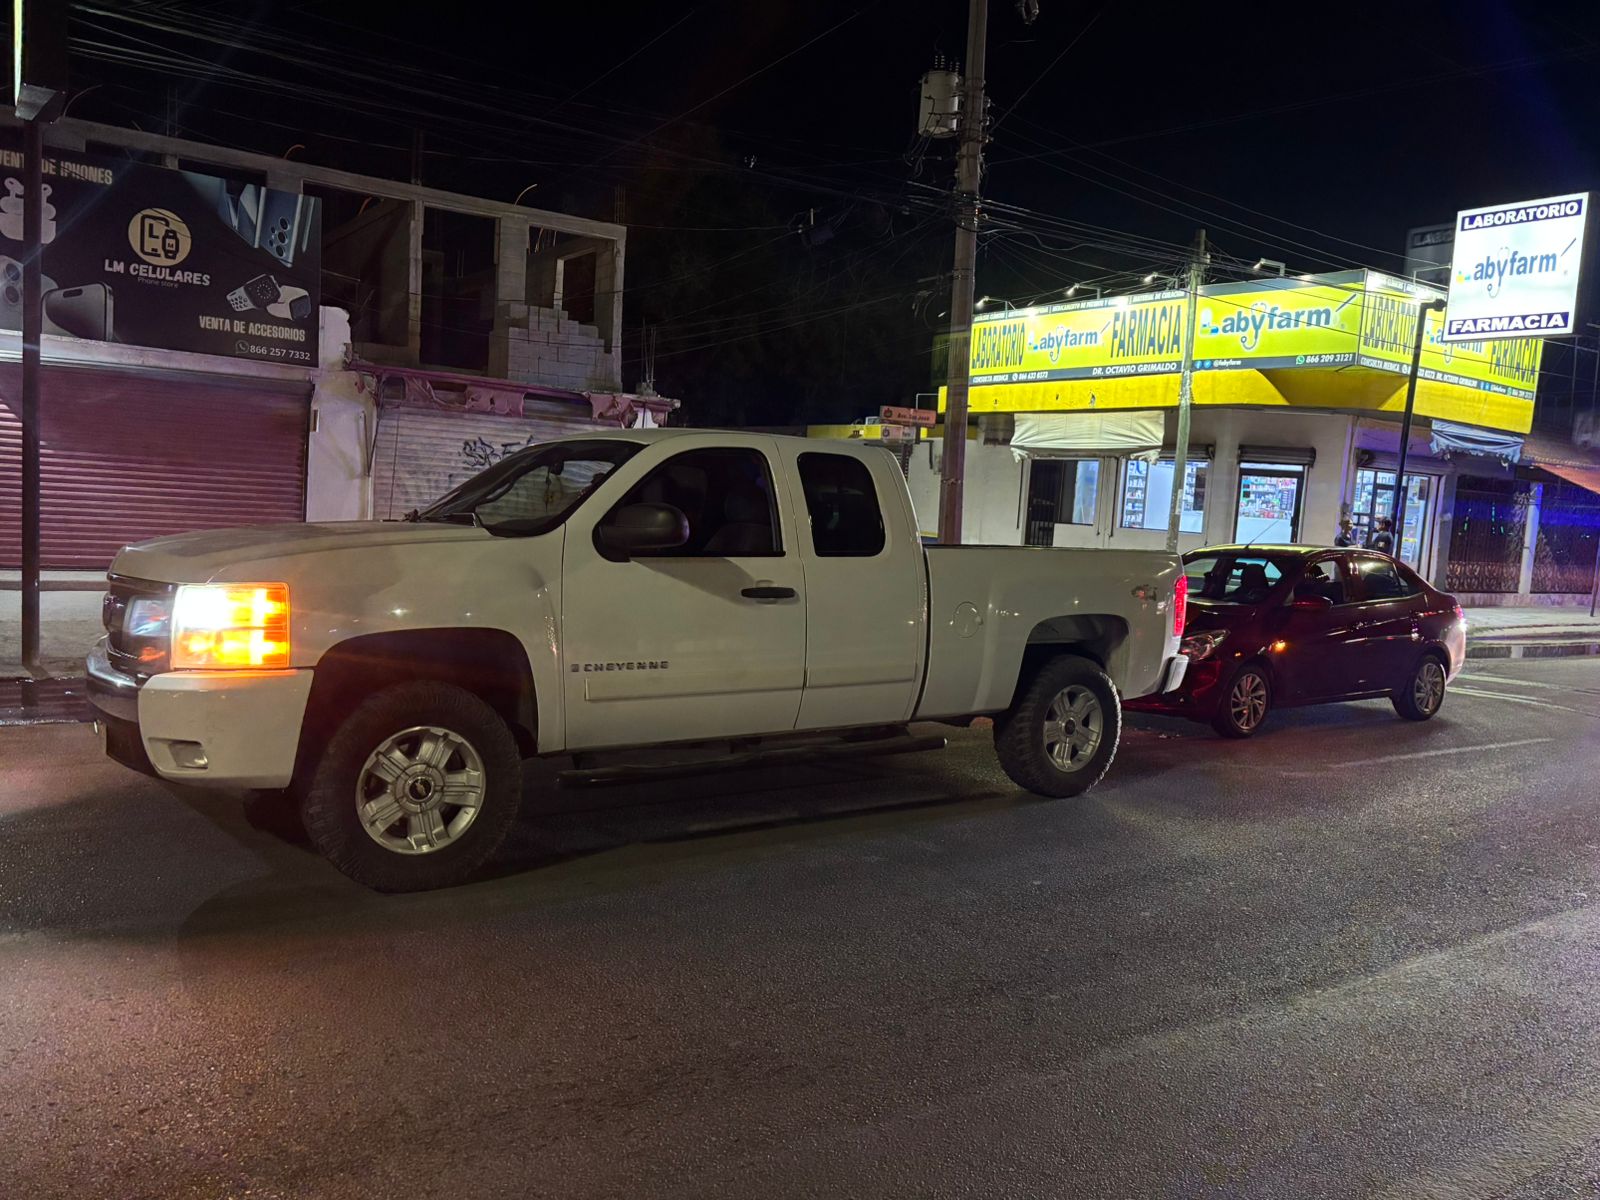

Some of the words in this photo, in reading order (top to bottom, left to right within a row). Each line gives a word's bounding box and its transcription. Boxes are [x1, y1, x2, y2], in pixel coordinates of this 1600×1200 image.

[0, 149, 25, 169] VENT
[41, 158, 57, 175] DE
[60, 160, 113, 185] IPHONES
[1463, 201, 1579, 230] LABORATORIO
[104, 259, 125, 274] LM
[129, 263, 211, 286] CELULARES
[199, 315, 231, 332] VENTA
[233, 320, 246, 334] DE
[248, 322, 306, 342] ACCESORIOS
[1110, 305, 1181, 359] FARMACIA
[1450, 313, 1565, 334] FARMACIA
[249, 345, 268, 355] 866
[270, 347, 287, 358] 257
[288, 349, 311, 361] 7332
[971, 322, 1025, 369] LABORATORIO
[1305, 355, 1320, 364] 866
[1321, 354, 1334, 363] 209
[1335, 353, 1353, 363] 3121
[1092, 367, 1103, 376] DR.
[1105, 364, 1137, 375] OCTAVIO
[1137, 361, 1177, 373] GRIMALDO
[583, 660, 670, 672] CHEYENNE
